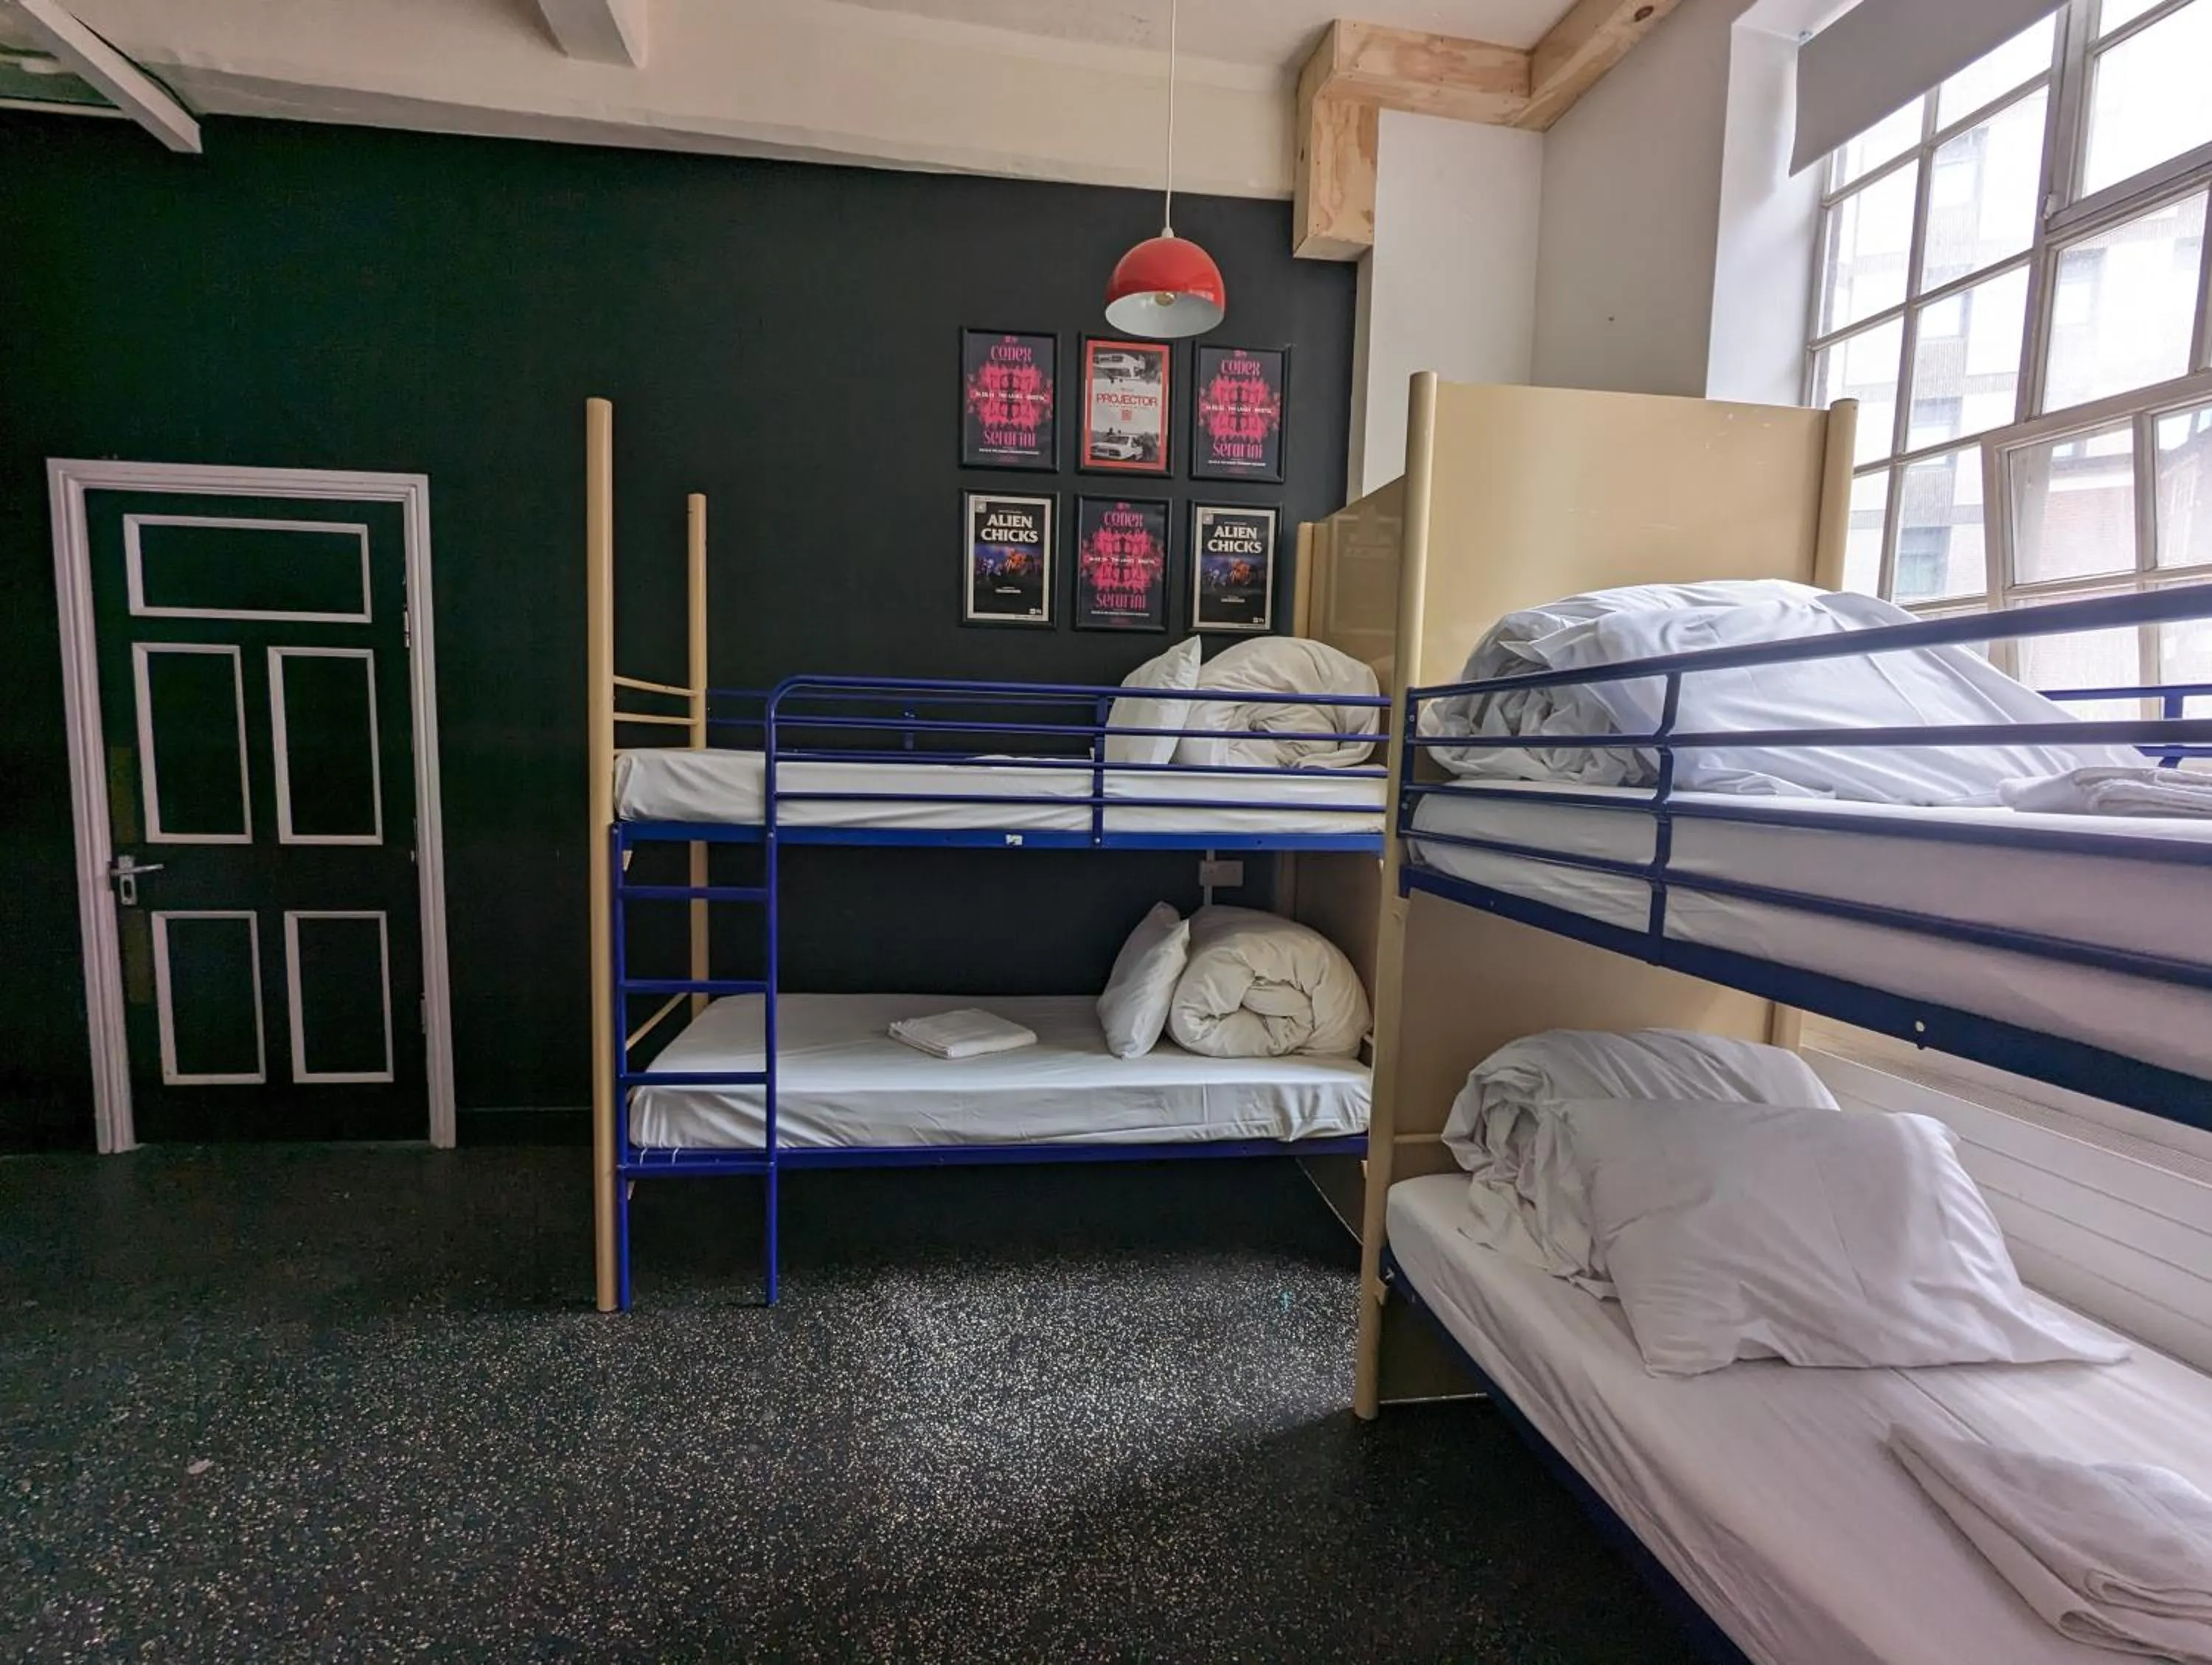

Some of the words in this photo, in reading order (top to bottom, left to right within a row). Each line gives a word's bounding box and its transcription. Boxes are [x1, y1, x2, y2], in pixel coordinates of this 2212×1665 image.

[1096, 392, 1158, 406] PROJECTOR
[987, 513, 1033, 529] ALIEN
[981, 527, 1039, 543] CHICKS
[1214, 524, 1258, 540] ALIEN
[1207, 539, 1262, 554] CHICKS
